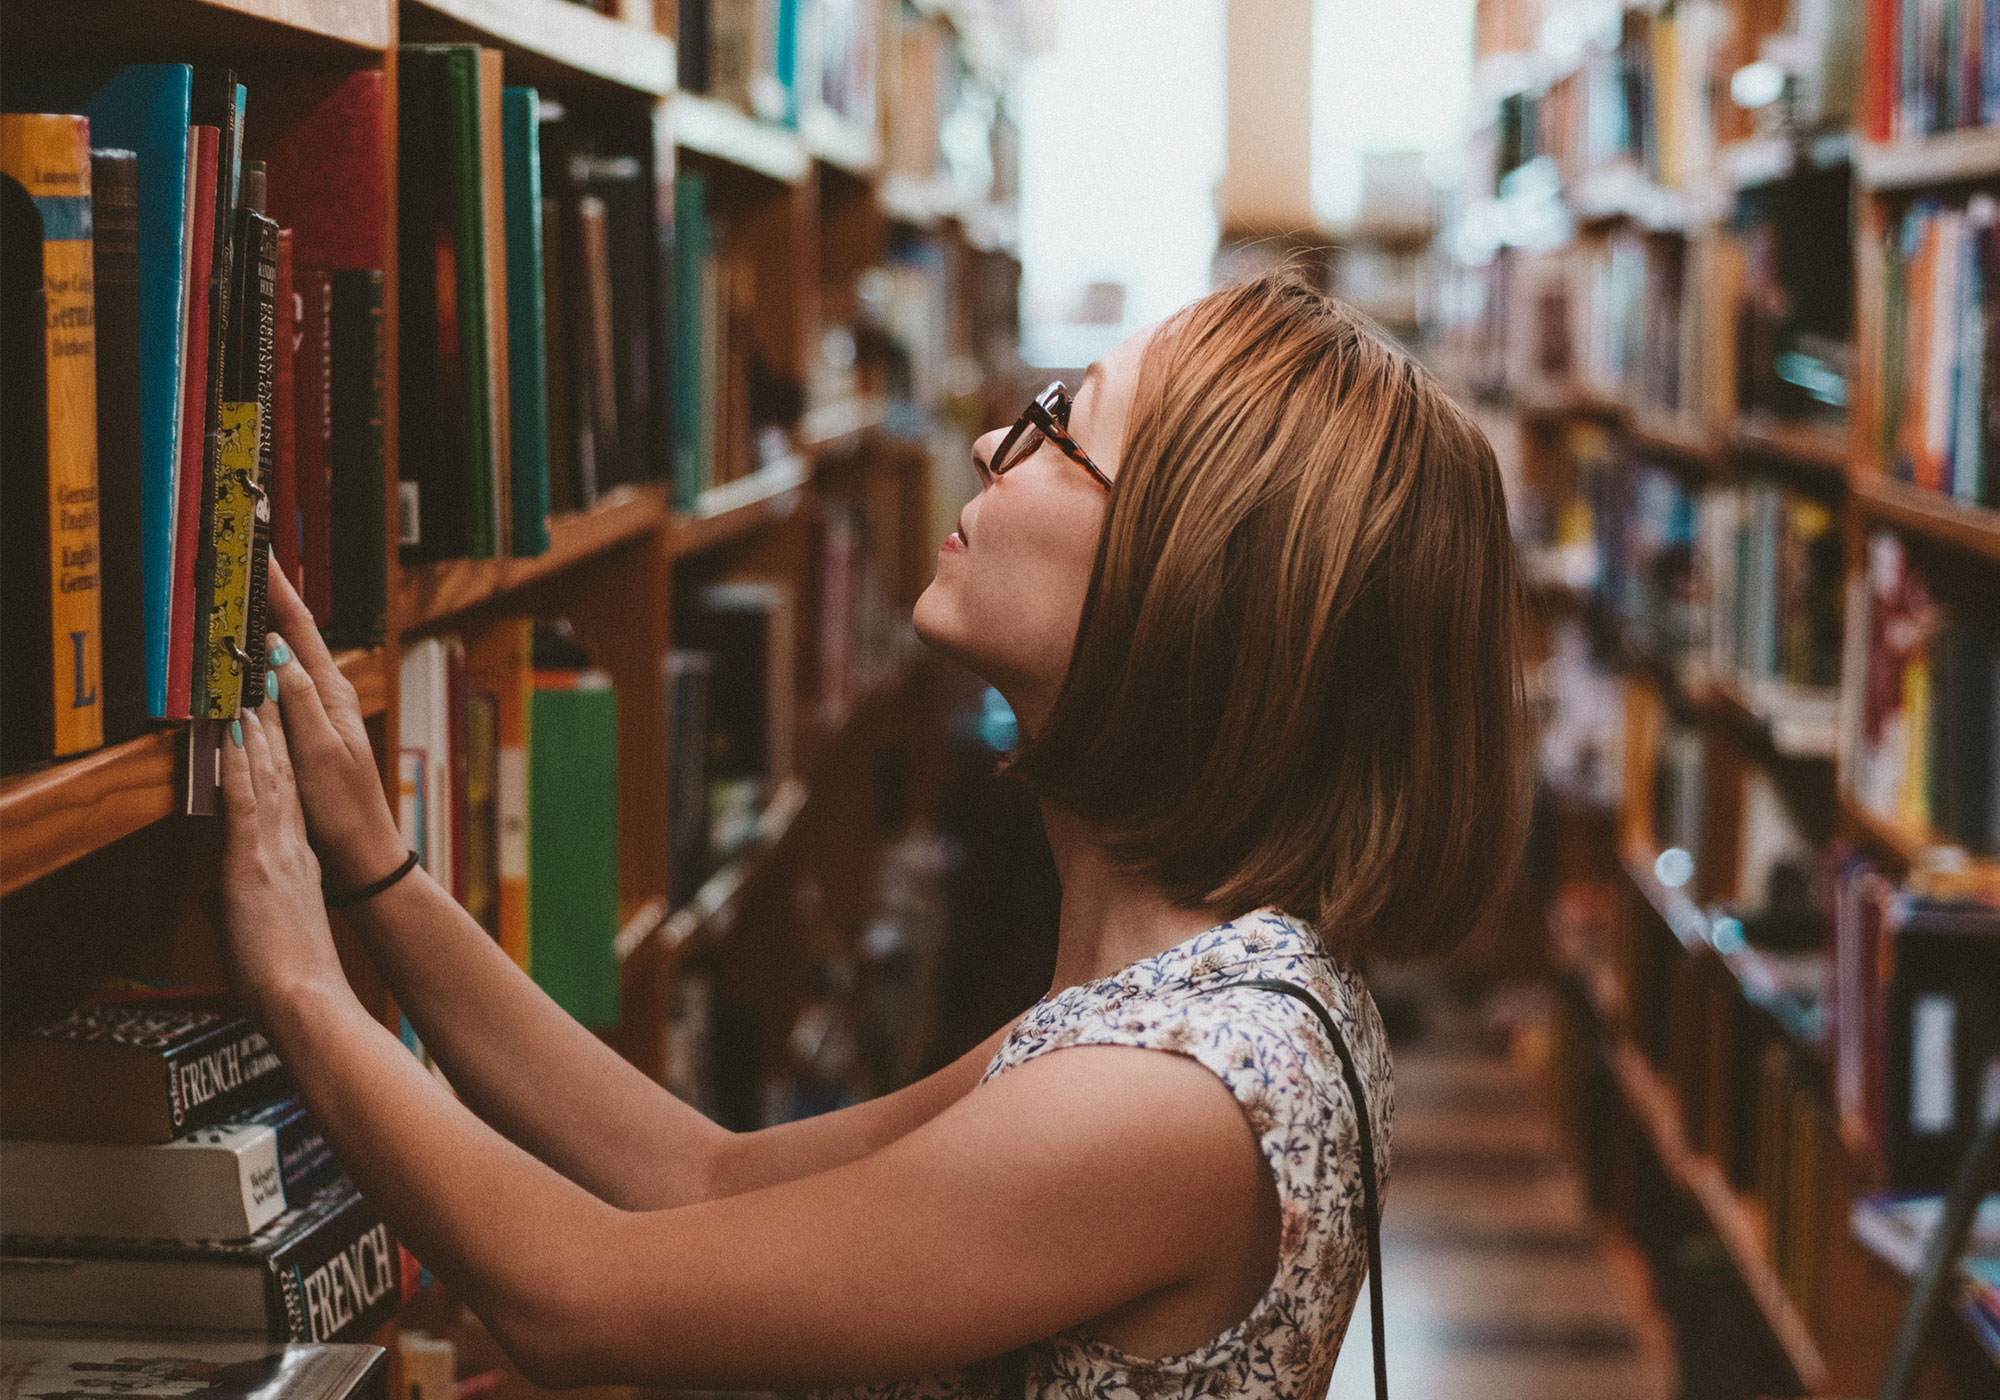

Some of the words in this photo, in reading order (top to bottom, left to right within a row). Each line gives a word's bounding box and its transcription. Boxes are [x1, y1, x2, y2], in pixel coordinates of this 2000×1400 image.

[70, 632, 96, 709] L
[180, 1043, 242, 1110] FRENCH
[303, 1222, 393, 1343] FRENCH
